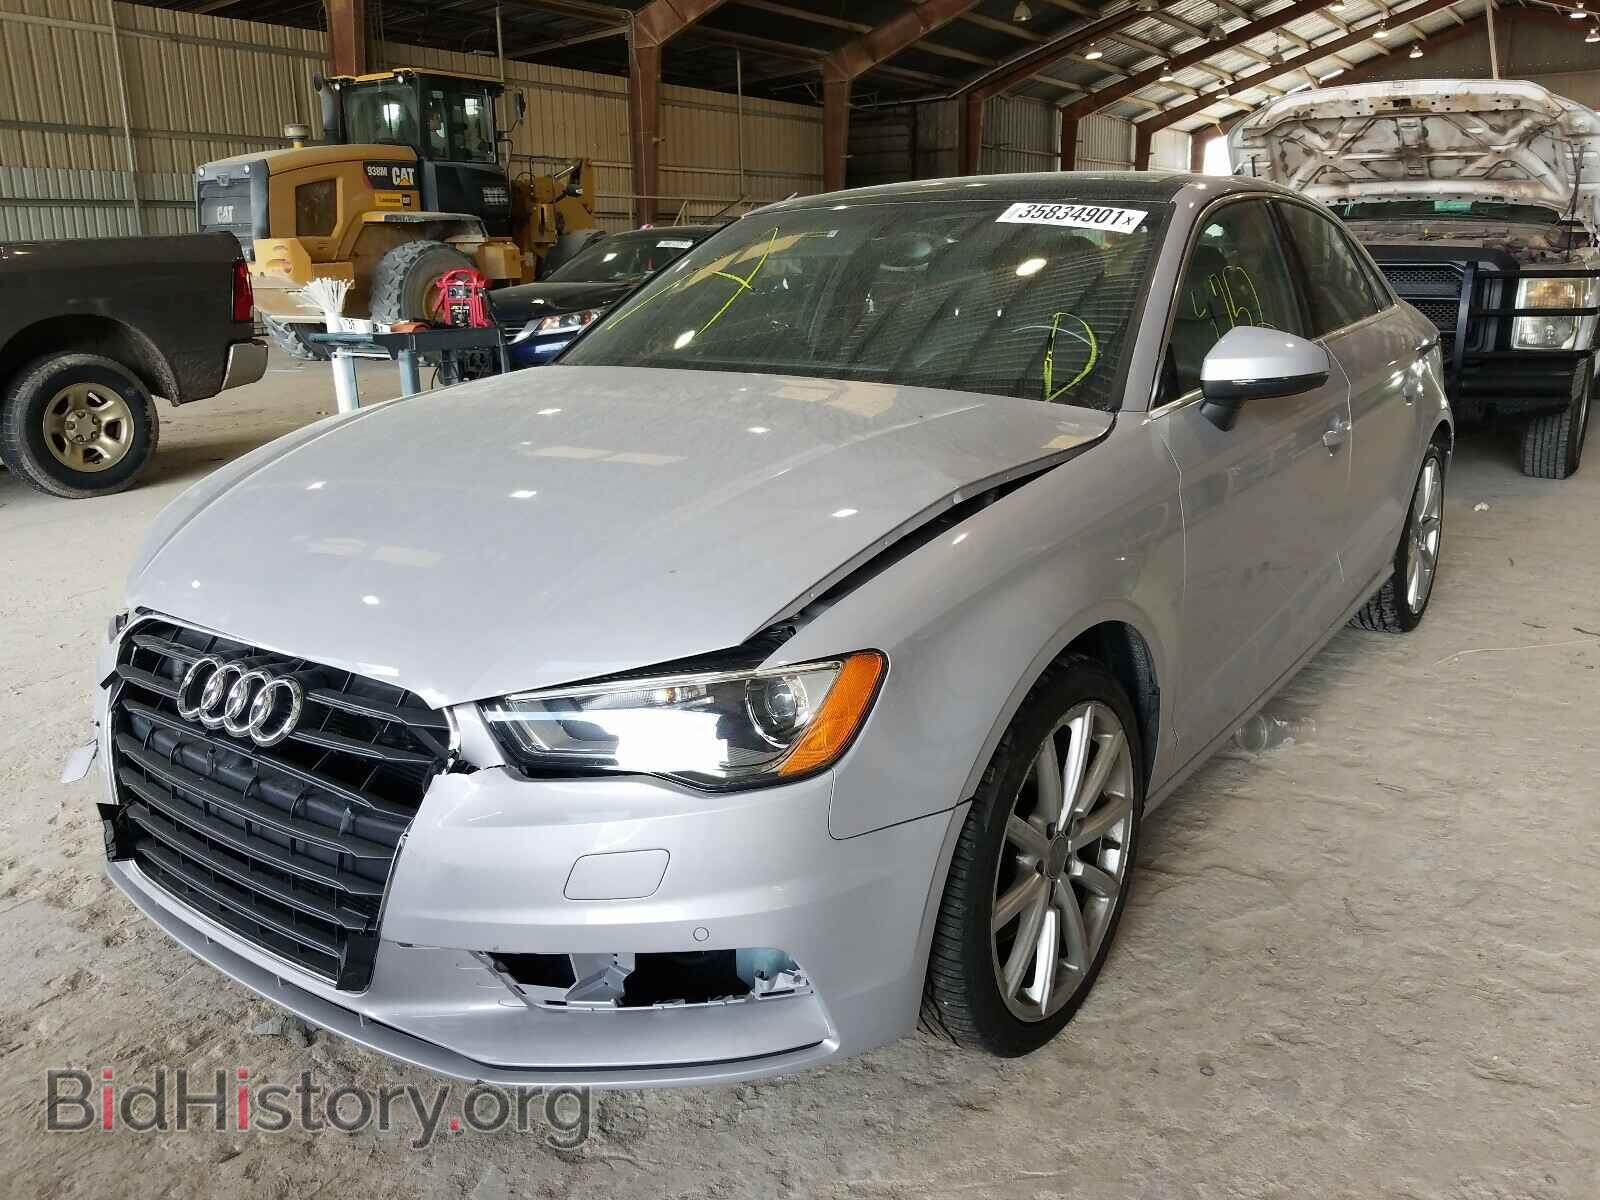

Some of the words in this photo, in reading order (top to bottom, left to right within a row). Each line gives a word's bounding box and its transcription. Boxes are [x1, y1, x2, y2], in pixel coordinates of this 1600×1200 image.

[367, 166, 388, 176] 938M
[391, 166, 415, 185] CAT
[216, 205, 233, 223] CAT
